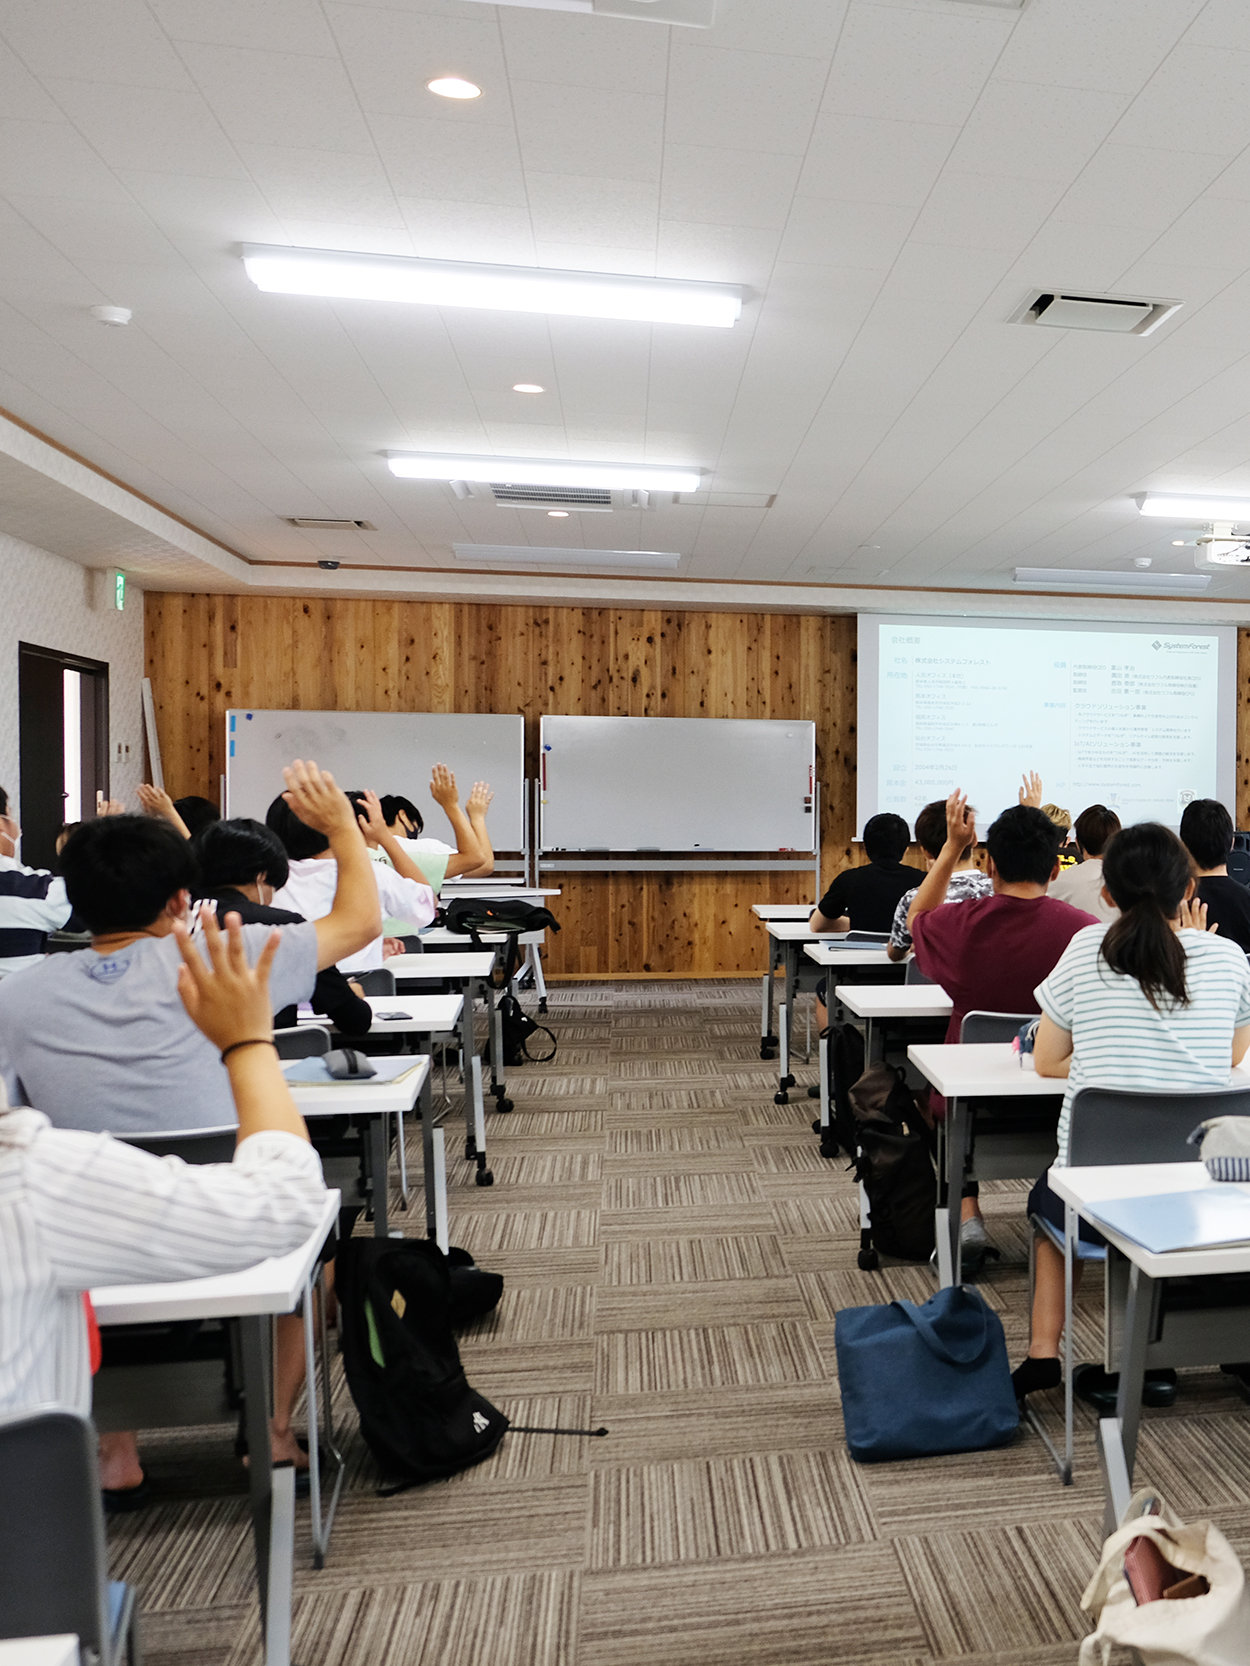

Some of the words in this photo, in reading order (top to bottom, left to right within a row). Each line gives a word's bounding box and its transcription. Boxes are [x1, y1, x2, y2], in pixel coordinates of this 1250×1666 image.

[1163, 642, 1211, 650] SystemForest
[894, 656, 908, 664] 社名
[915, 657, 991, 666] 株式会社システムフォレスト
[886, 671, 908, 679] 所在地
[1074, 703, 1147, 711] クラウドソリューション事業
[914, 779, 954, 787] 43,000,000円
